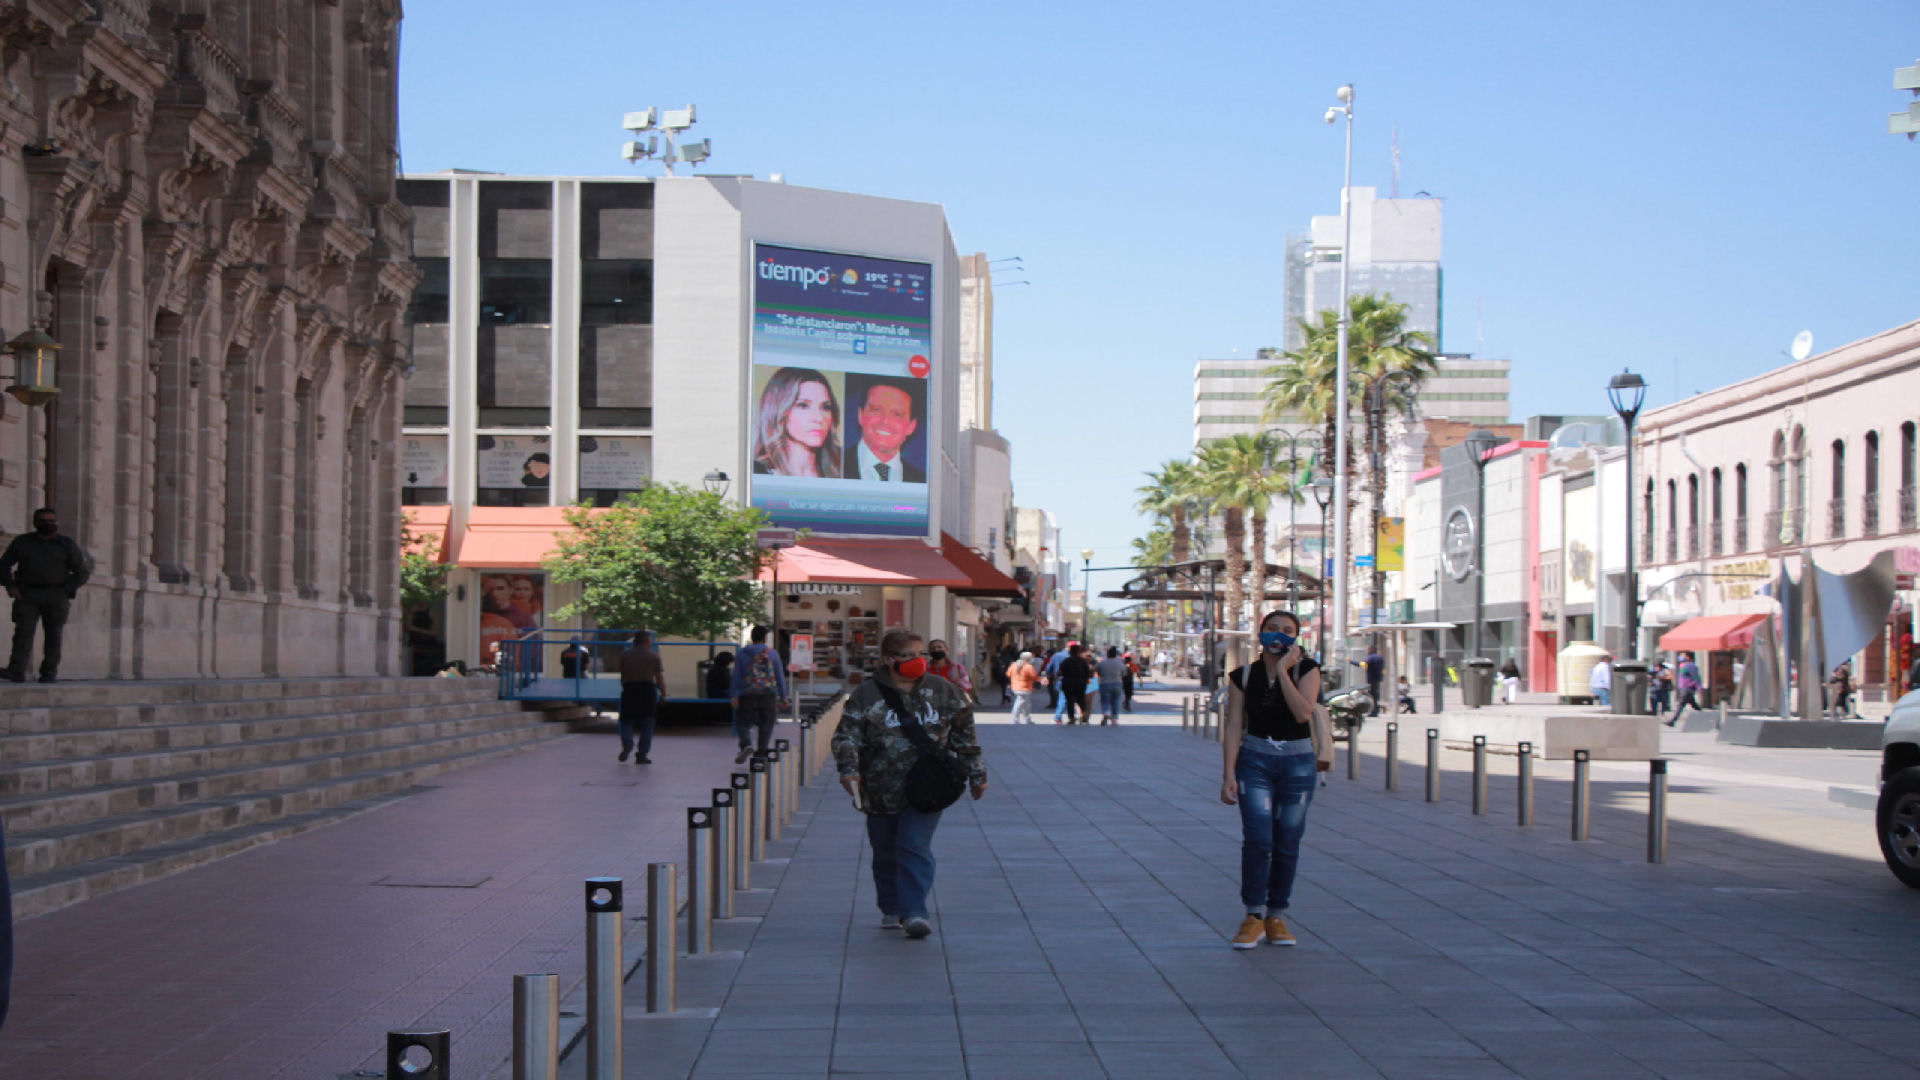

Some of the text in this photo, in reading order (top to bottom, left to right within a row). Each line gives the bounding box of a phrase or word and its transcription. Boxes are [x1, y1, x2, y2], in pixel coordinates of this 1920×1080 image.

[758, 257, 831, 290] tiempo
[866, 322, 897, 336] Mamá
[897, 325, 910, 337] de
[867, 333, 903, 346] ruptura
